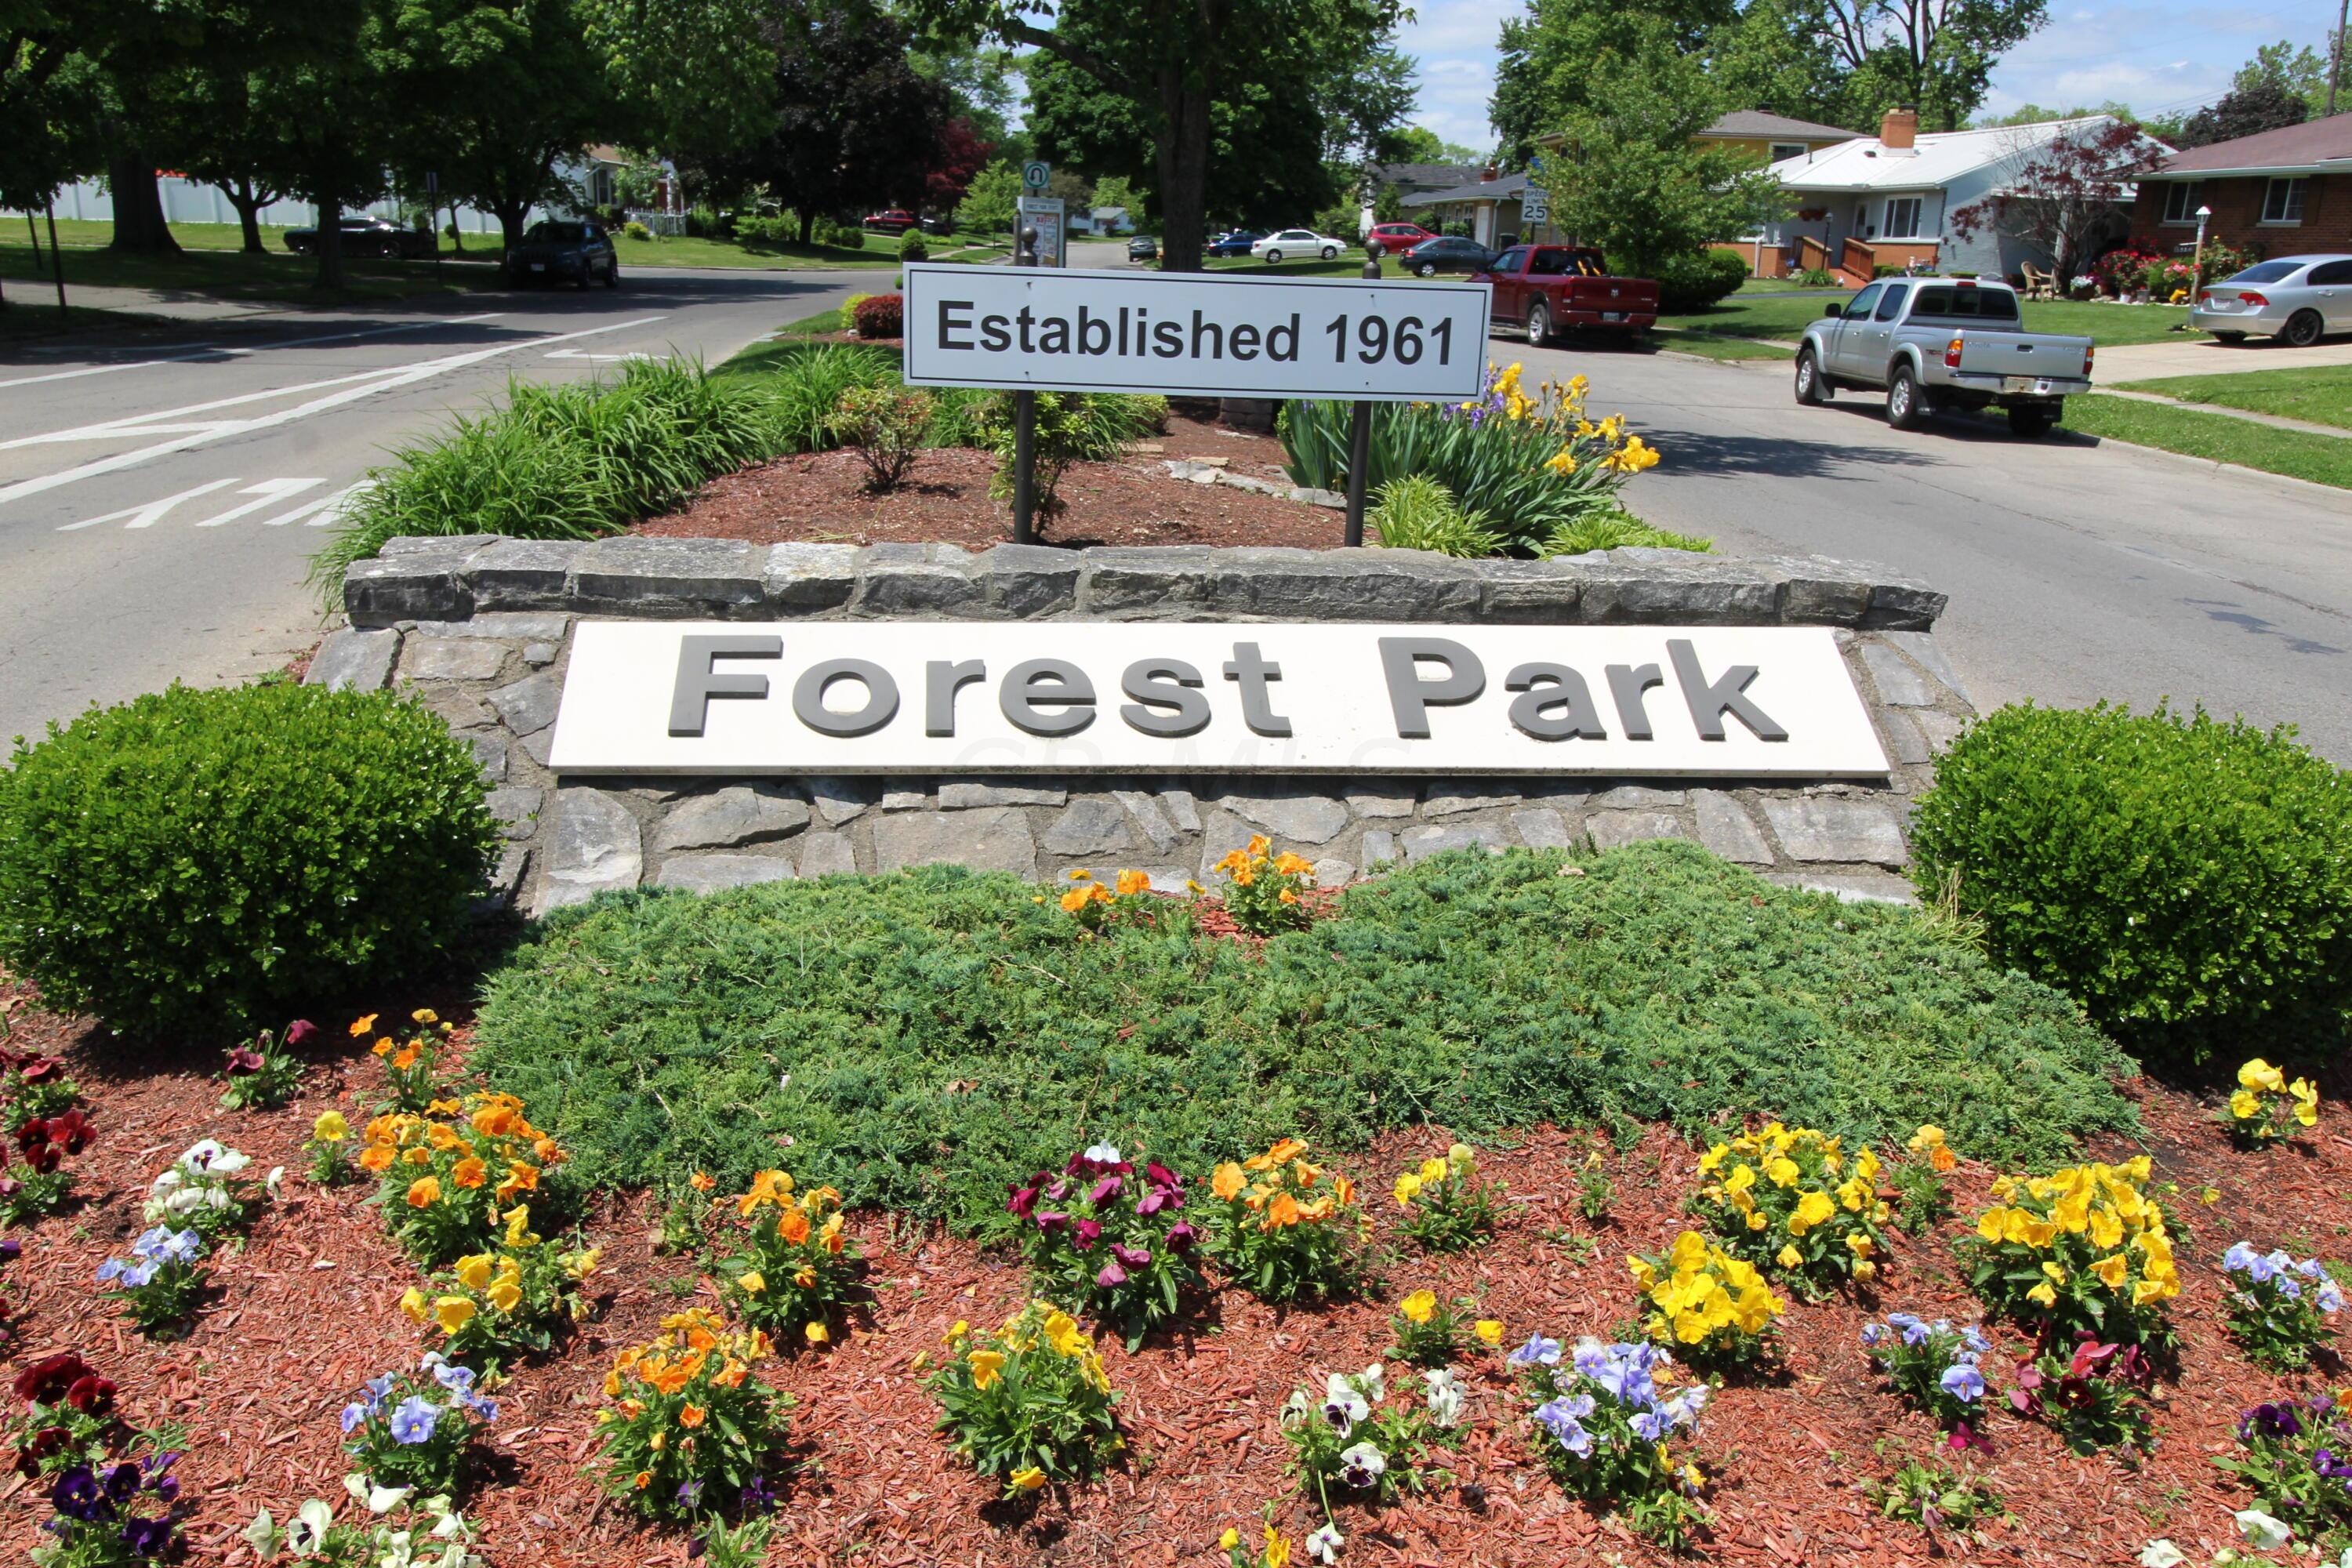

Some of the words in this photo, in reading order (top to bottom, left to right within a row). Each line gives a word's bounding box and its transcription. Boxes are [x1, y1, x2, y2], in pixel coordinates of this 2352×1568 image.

[1523, 205, 1547, 219] 25
[937, 299, 1301, 363] Established
[1325, 313, 1454, 366] 1961
[667, 634, 1294, 739] Forest
[1377, 637, 1789, 742] Park
